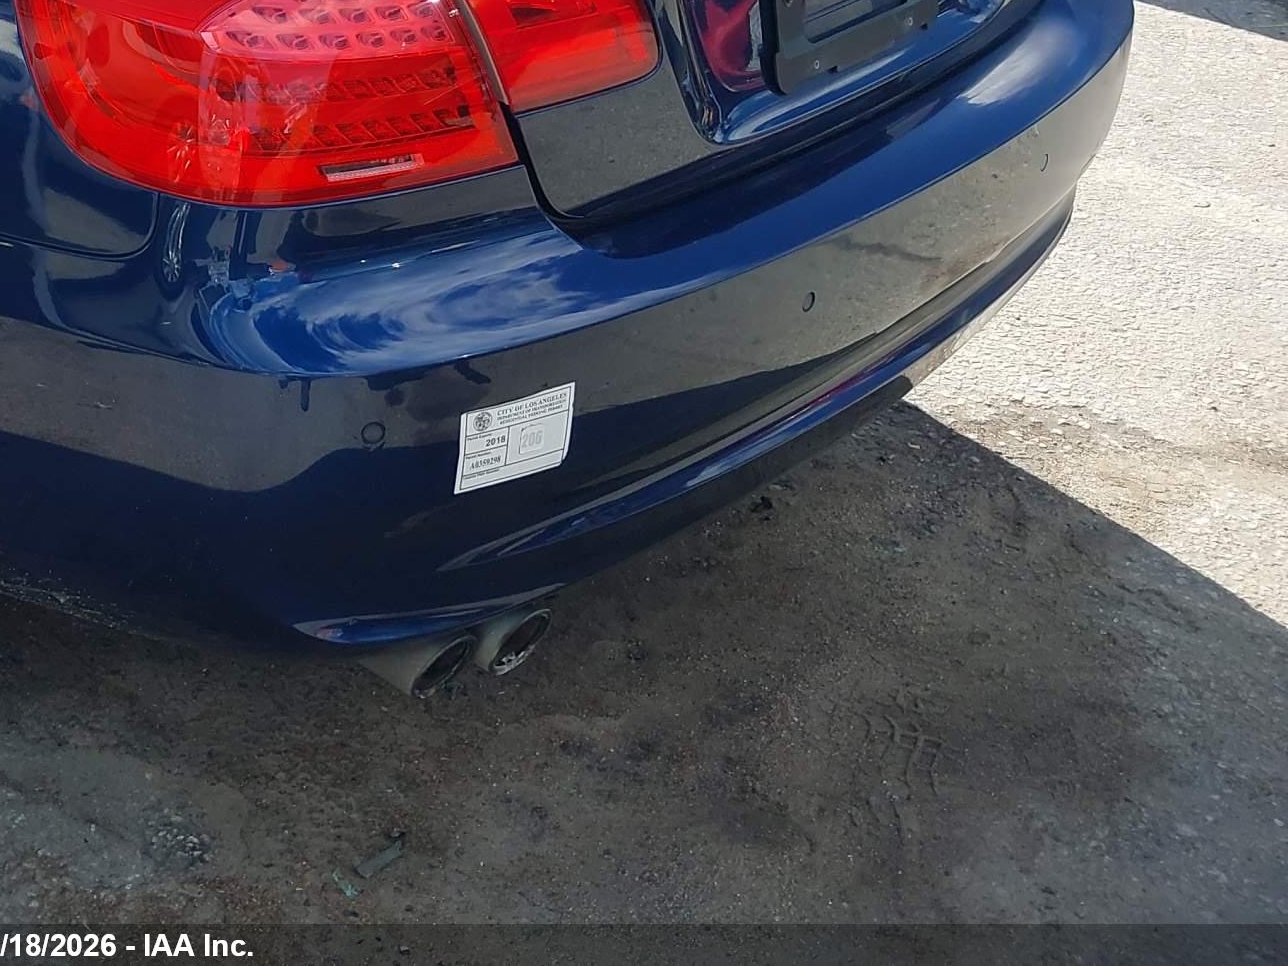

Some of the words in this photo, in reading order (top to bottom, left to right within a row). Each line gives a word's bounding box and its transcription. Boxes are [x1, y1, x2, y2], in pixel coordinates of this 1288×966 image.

[497, 406, 513, 416] CITY
[515, 404, 524, 412] OF
[525, 401, 538, 409] LOS
[539, 393, 567, 405] ANGELES
[485, 435, 506, 447] 2018
